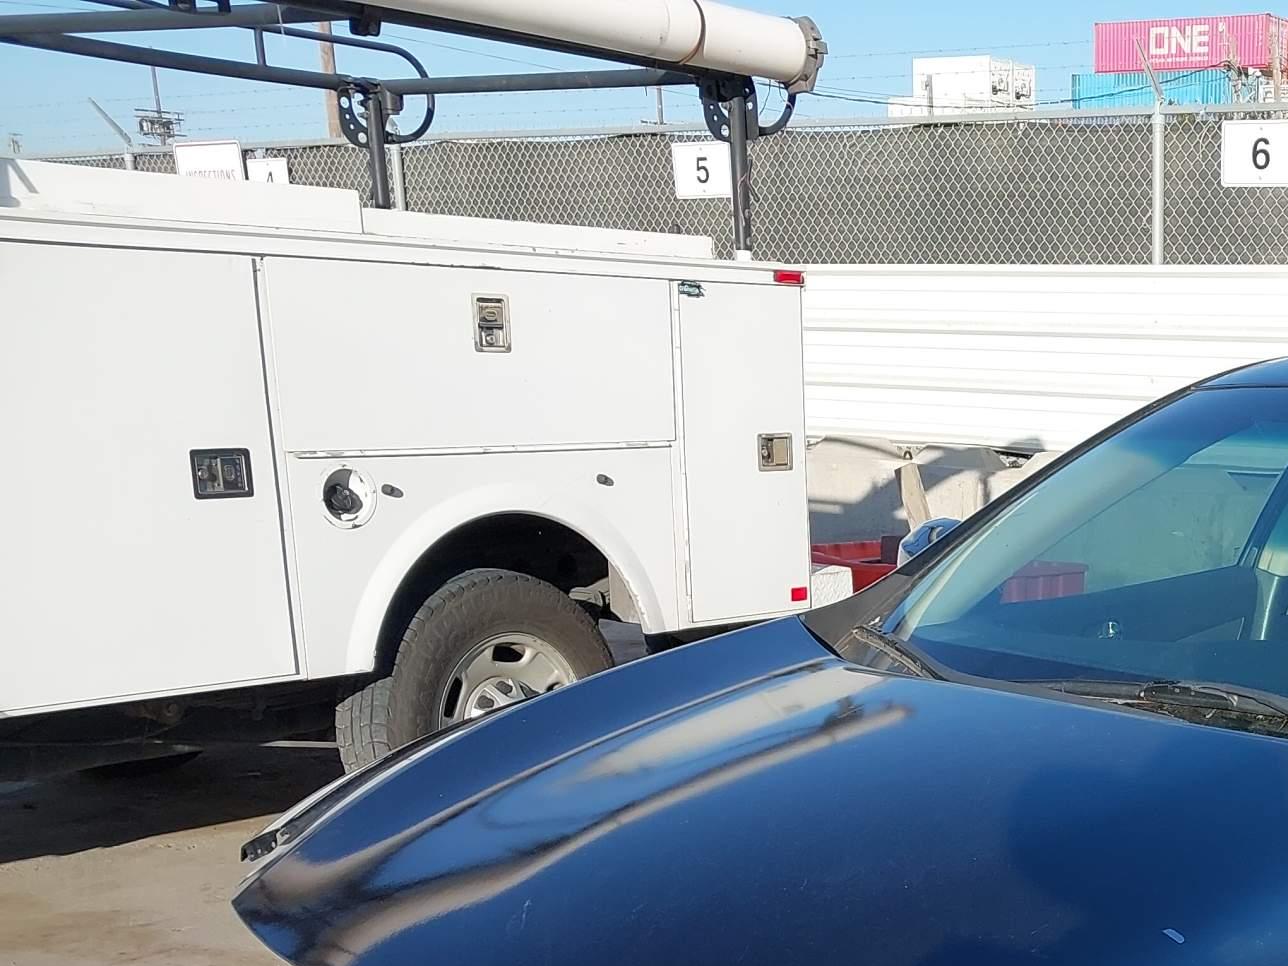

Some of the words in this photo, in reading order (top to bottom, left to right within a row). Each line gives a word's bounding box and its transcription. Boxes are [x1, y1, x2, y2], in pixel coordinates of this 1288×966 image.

[1149, 24, 1209, 55] ONE
[1251, 137, 1271, 170] 6
[696, 156, 710, 184] 5
